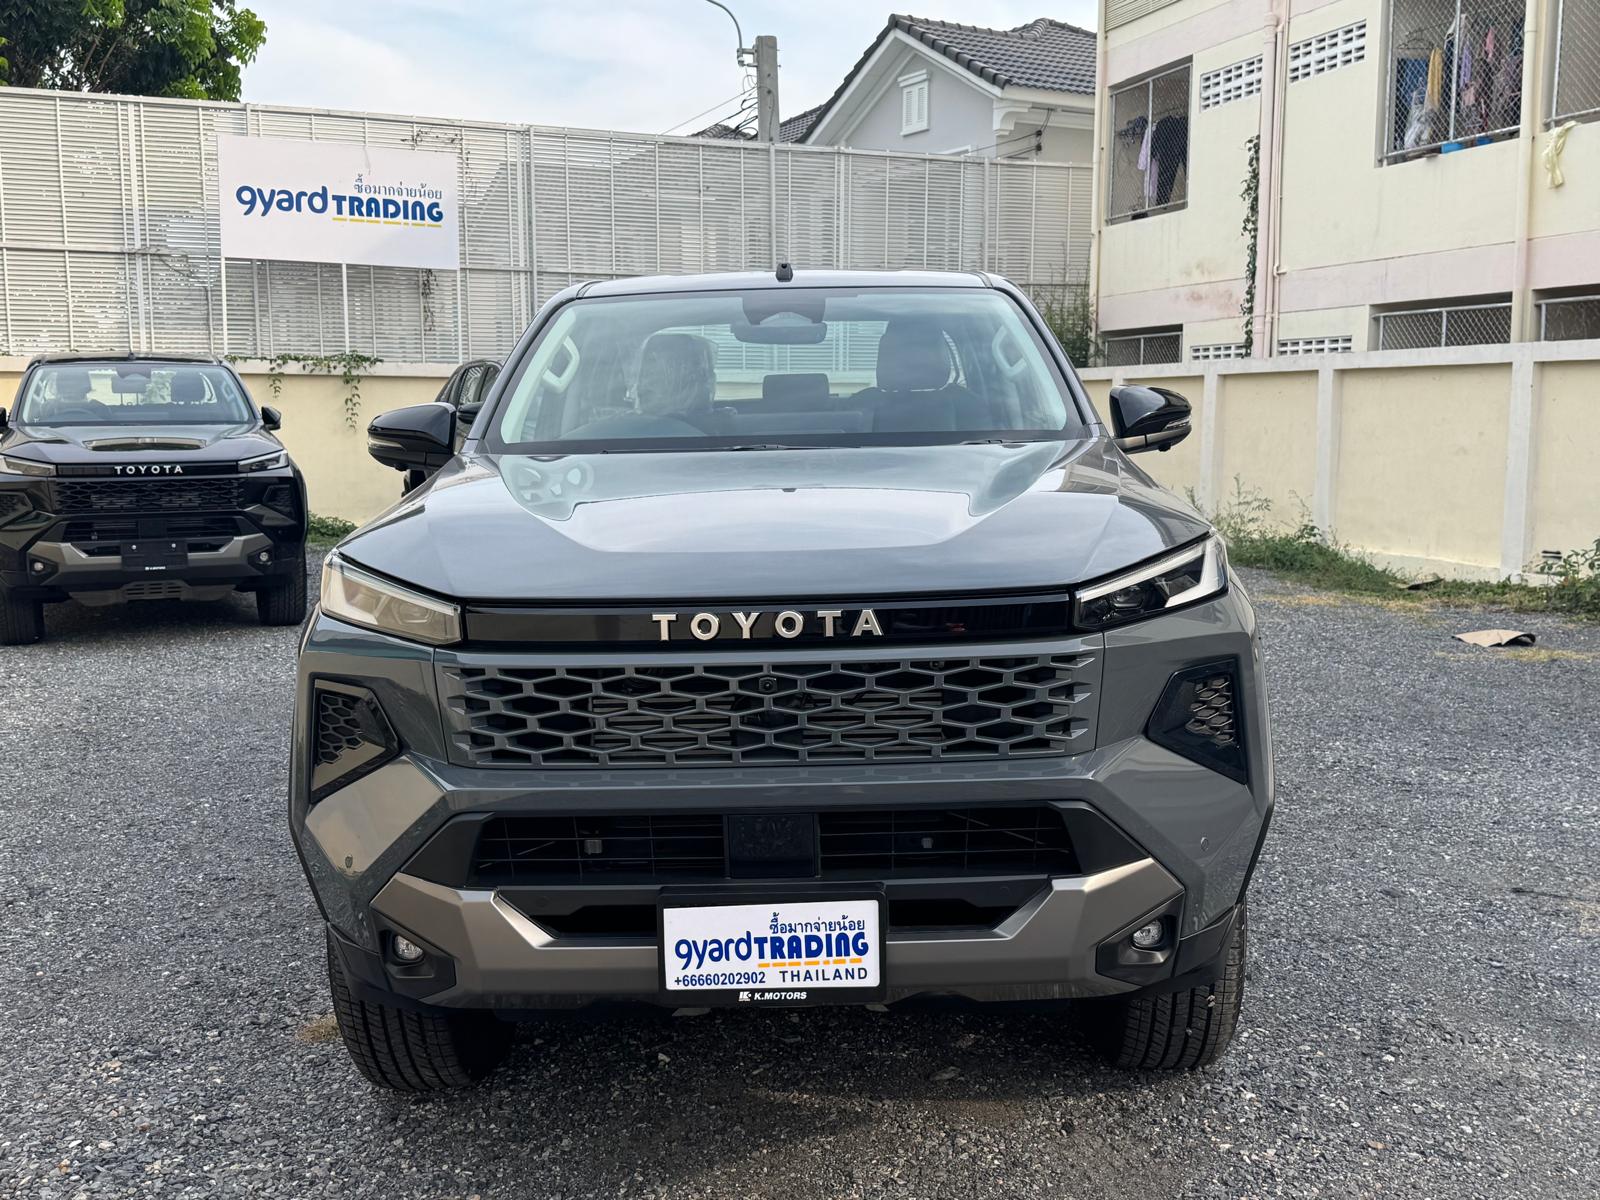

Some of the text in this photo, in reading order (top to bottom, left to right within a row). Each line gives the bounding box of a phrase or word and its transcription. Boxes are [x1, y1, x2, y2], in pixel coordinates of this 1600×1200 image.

[353, 173, 443, 200] ซื้อมากจ่ายน้อย
[235, 185, 444, 223] 9yard TRADING
[114, 465, 183, 475] TOYOTA
[651, 608, 885, 641] TOYOTA
[769, 911, 866, 935] ซื้อมากจ่ายน้อย
[674, 930, 869, 970] 9yard TRADING
[674, 967, 869, 987] +66660202902 THAILAND
[753, 990, 808, 1001] K.MOTORS
